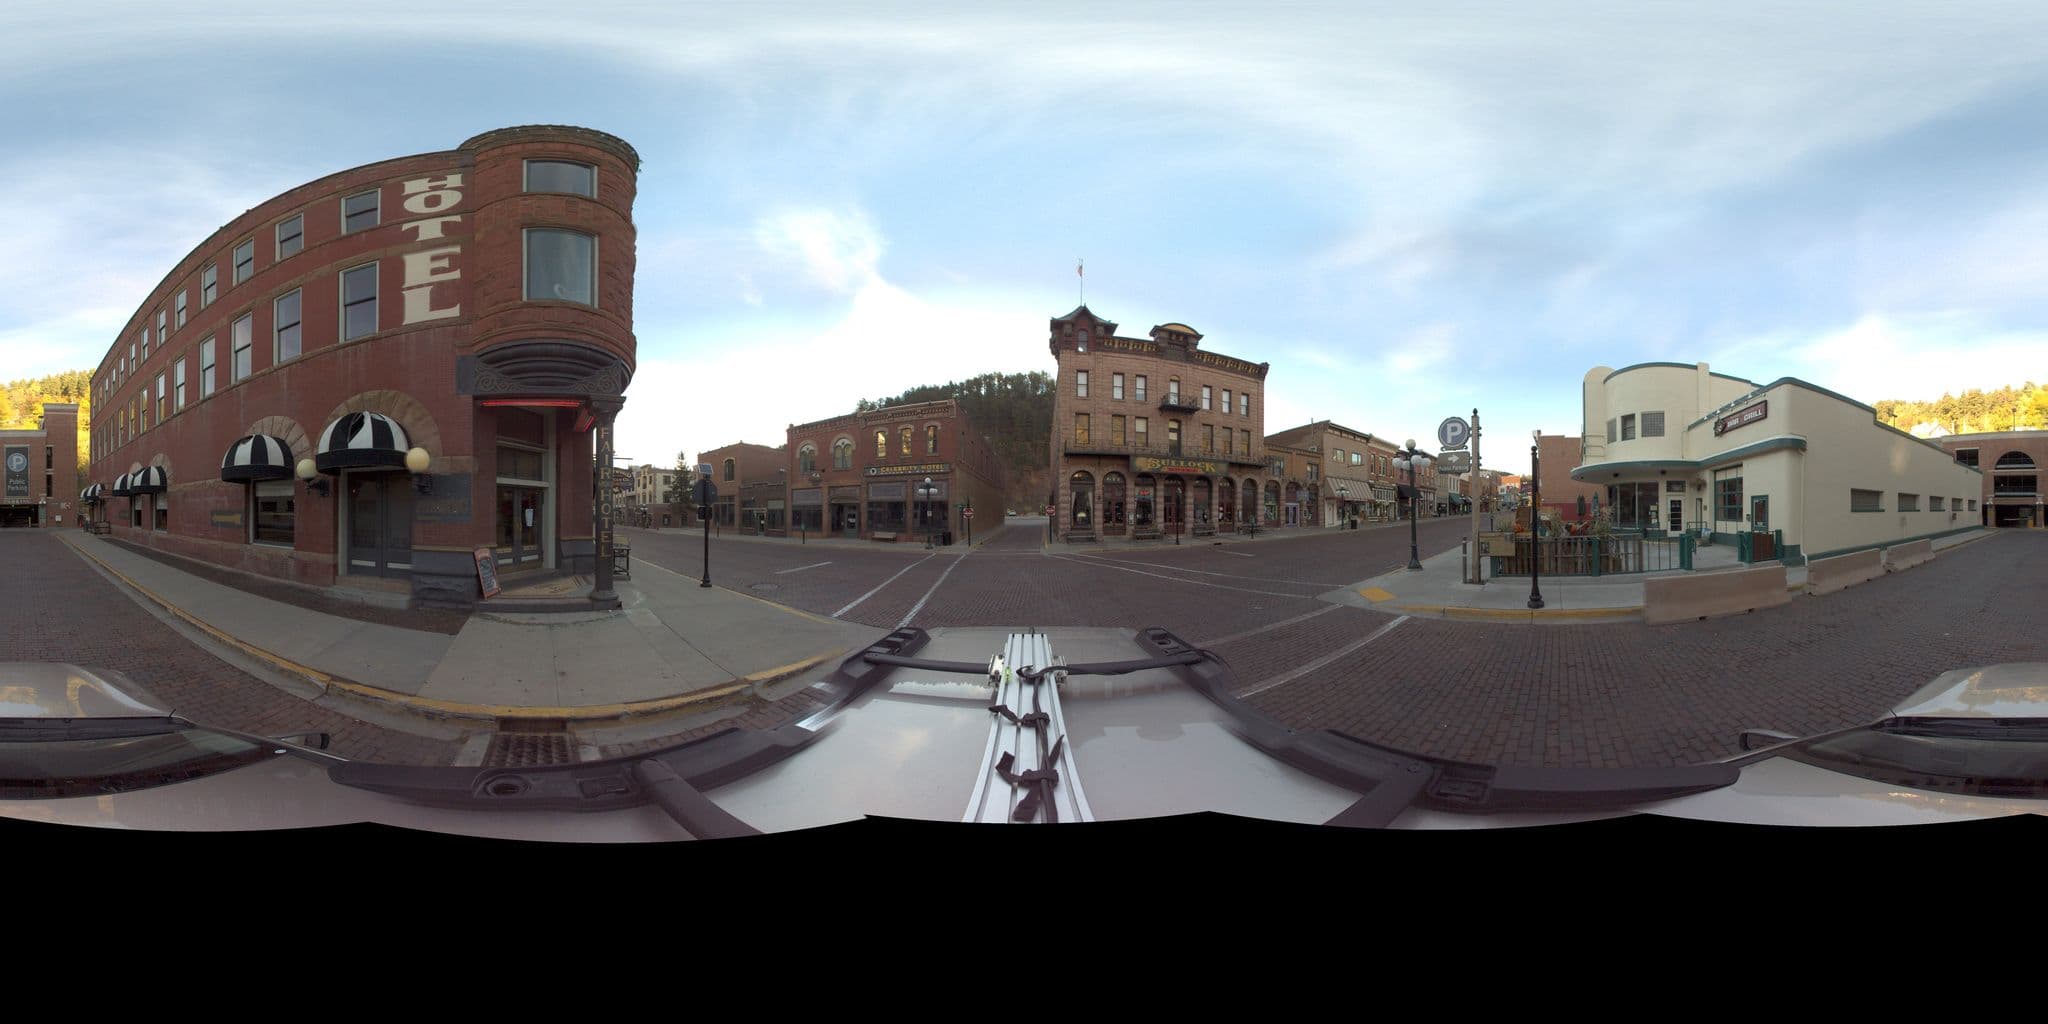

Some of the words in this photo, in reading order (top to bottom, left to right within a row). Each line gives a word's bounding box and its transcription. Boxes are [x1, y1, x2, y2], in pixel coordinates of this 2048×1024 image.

[401, 173, 465, 326] HOTEL
[1446, 422, 1463, 444] P
[1744, 409, 1762, 421] GRILL
[600, 427, 611, 479] FAIR
[1148, 457, 1216, 473] BULLOCK
[600, 489, 611, 557] HOTEL
